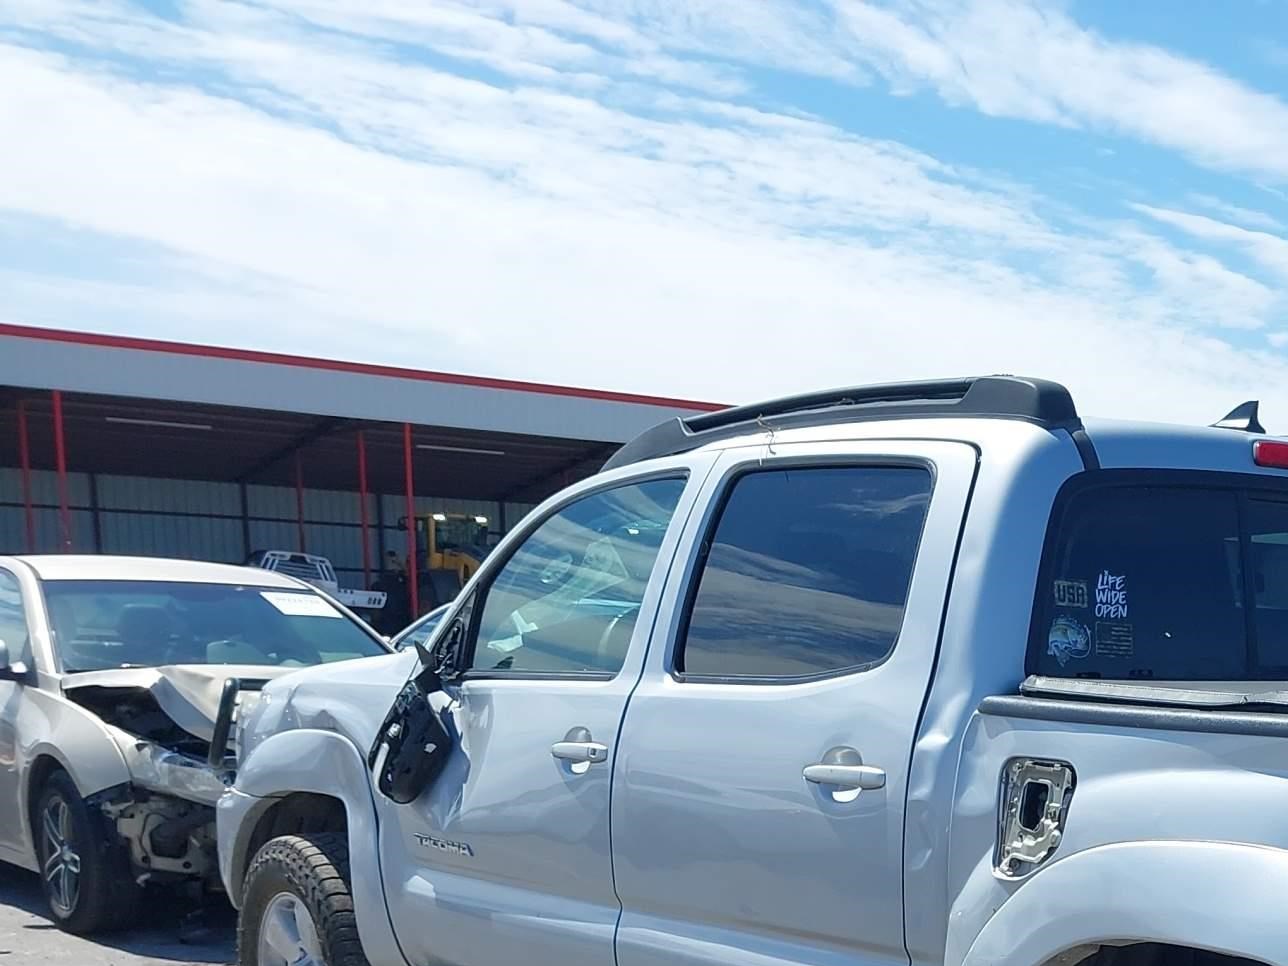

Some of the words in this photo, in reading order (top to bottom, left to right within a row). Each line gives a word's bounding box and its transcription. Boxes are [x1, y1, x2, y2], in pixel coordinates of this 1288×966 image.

[1097, 569, 1126, 590] LIFE
[1055, 582, 1086, 607] USA
[1095, 588, 1127, 605] WIDE
[1095, 603, 1128, 618] OPEN
[413, 832, 474, 857] TACOMA
